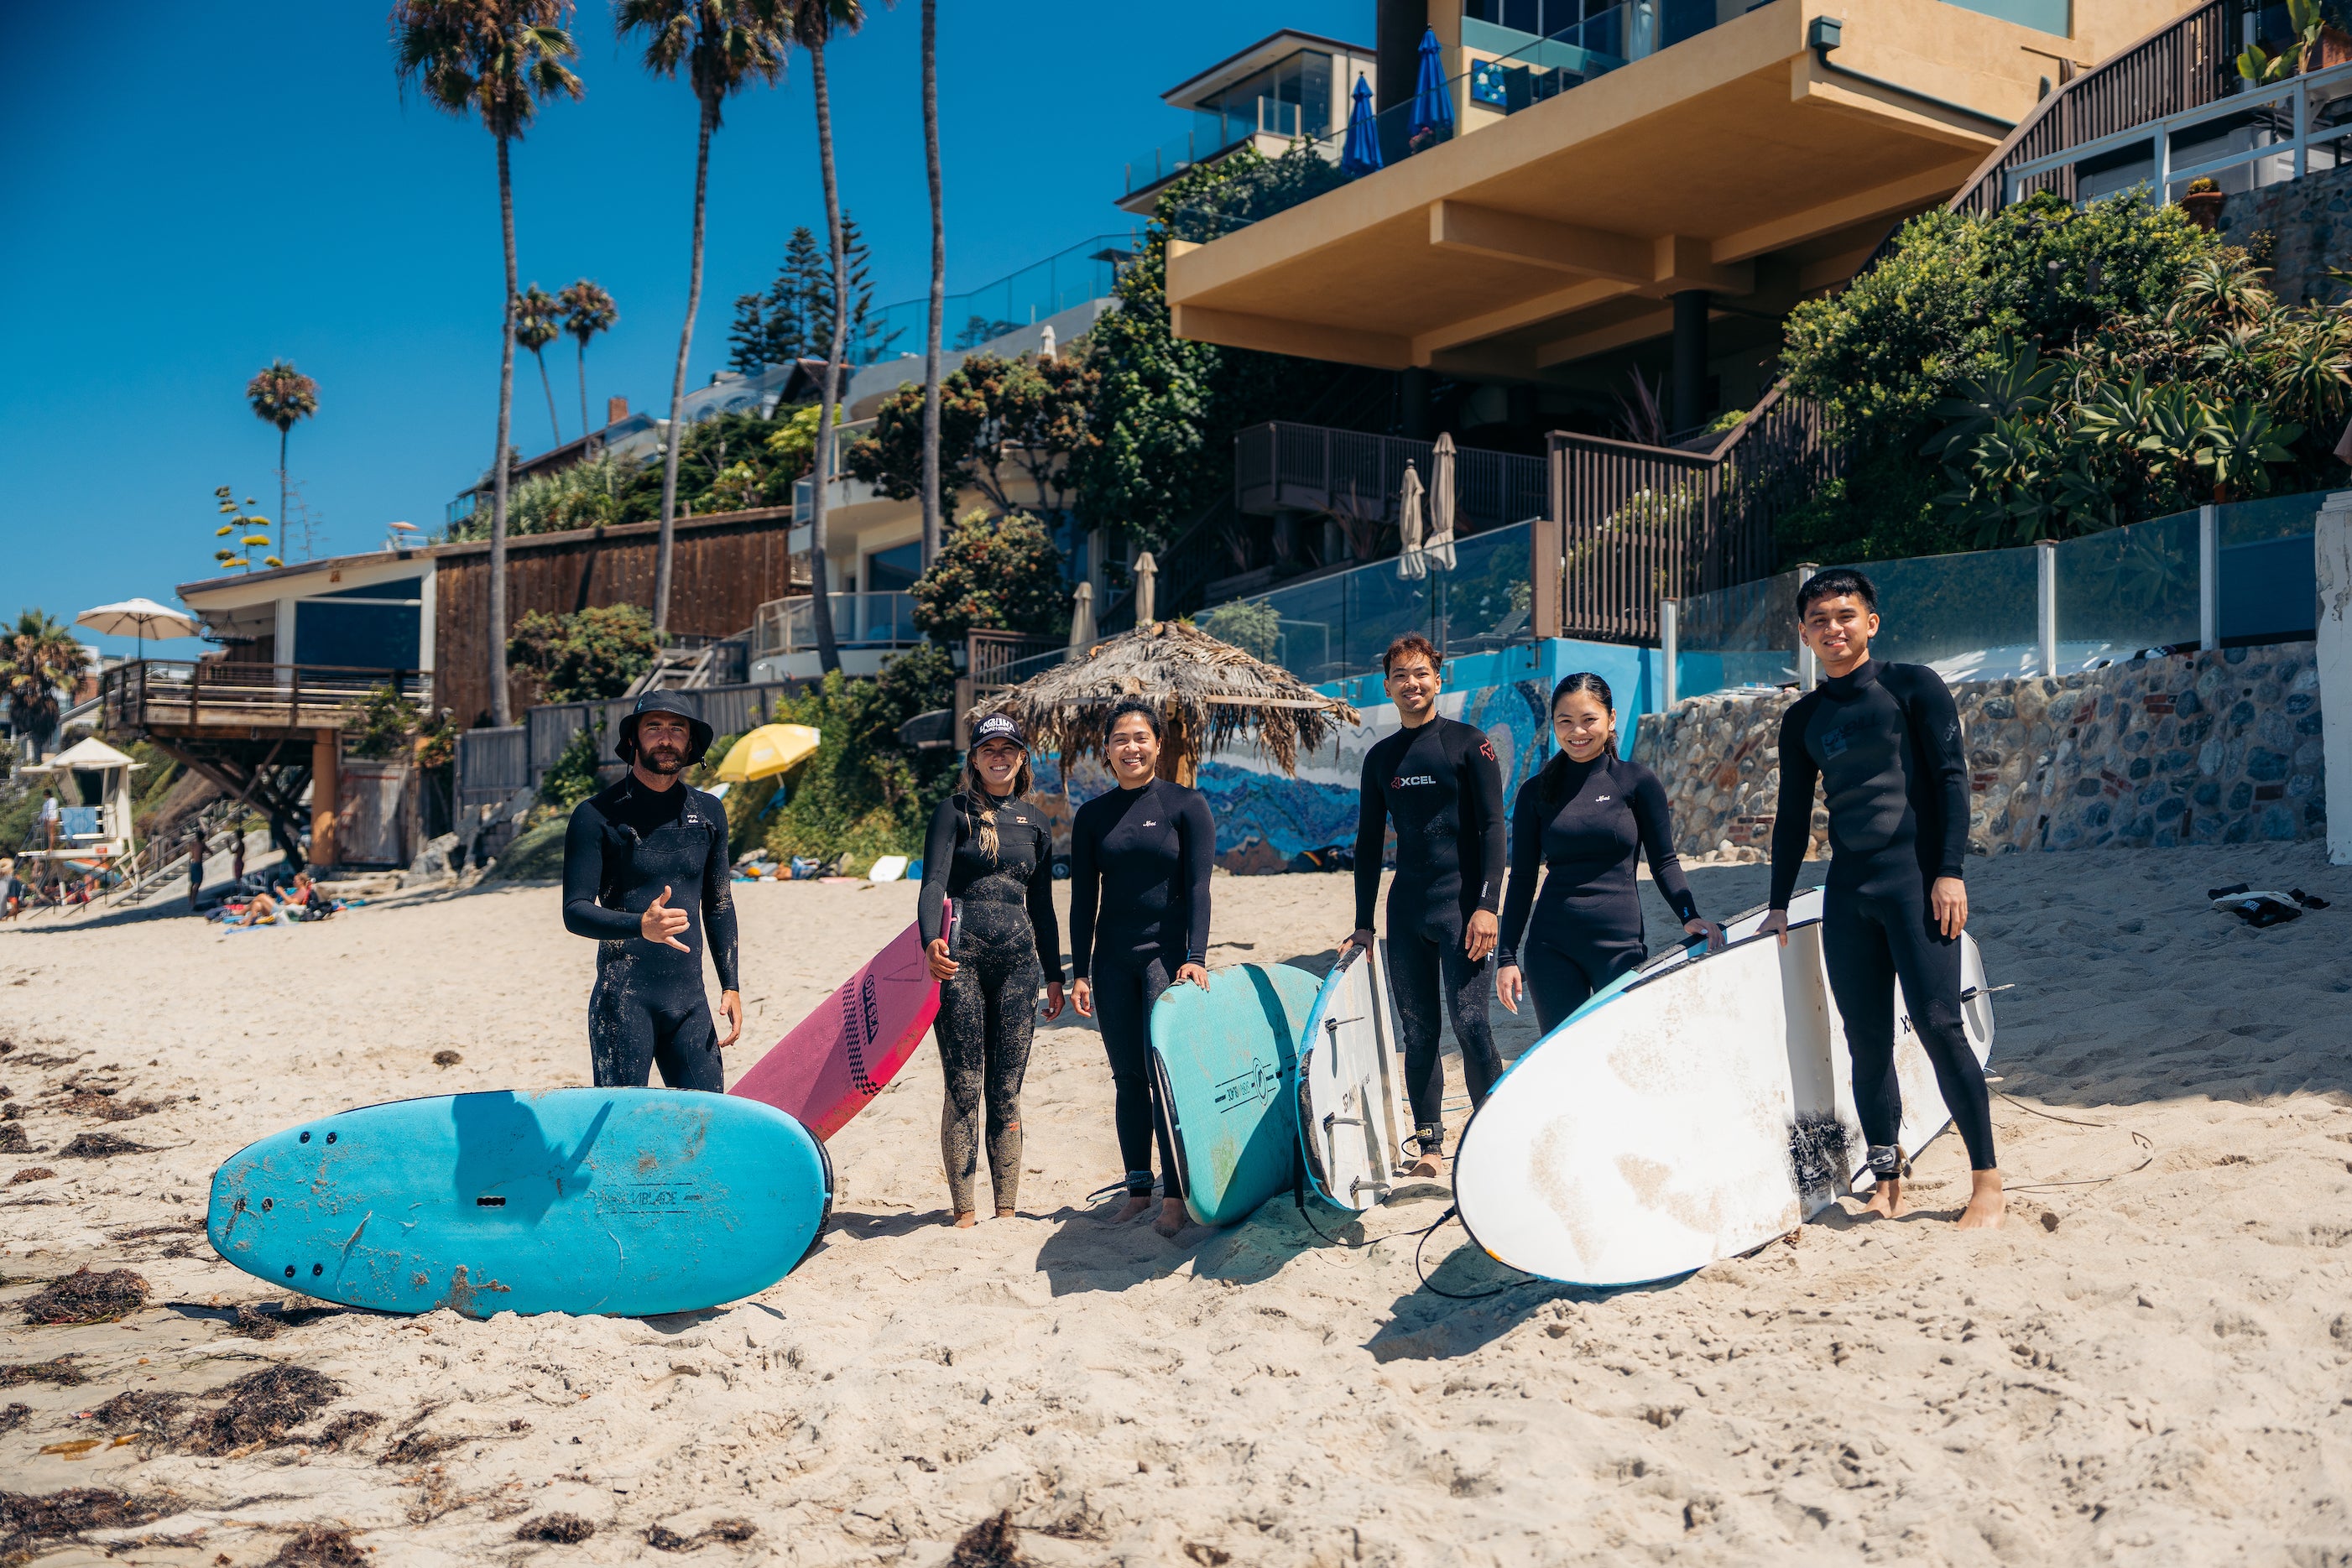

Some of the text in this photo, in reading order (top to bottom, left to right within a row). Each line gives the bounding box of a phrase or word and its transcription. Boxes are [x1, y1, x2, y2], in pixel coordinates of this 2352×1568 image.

[979, 717, 1016, 733] LAGUNA
[1400, 775, 1437, 787] XCEL
[862, 974, 879, 1044] ODYSEA
[1867, 1154, 1893, 1167] FCS
